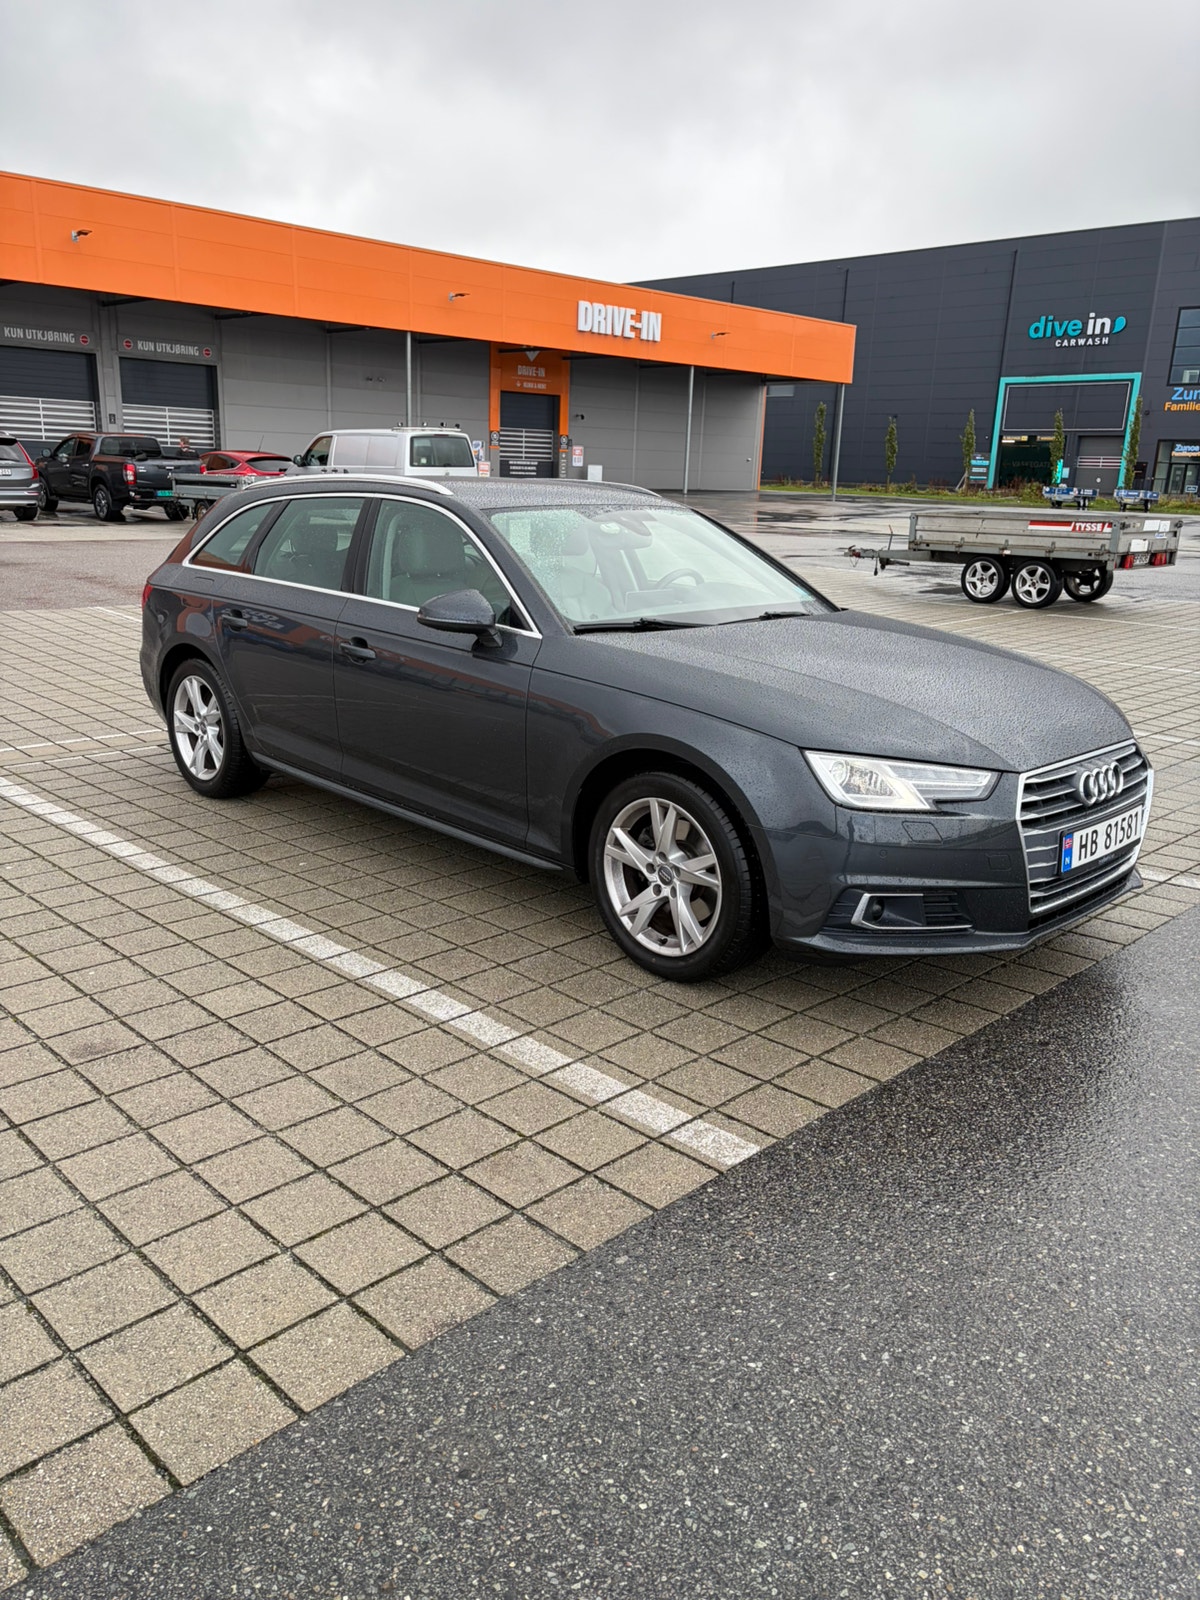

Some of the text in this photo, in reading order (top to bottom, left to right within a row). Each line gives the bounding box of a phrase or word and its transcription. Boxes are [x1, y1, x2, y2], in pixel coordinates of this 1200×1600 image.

[577, 300, 662, 342] DRIVE-IN
[1028, 312, 1111, 339] dive in
[3, 326, 76, 344] KUN UTKJØRING
[1055, 336, 1110, 348] CARWASH
[137, 340, 199, 356] KUN UTKJØRING
[517, 364, 546, 378] DRIVE-IN
[1075, 521, 1103, 533] TYSSE
[1078, 812, 1139, 862] HB 81581
